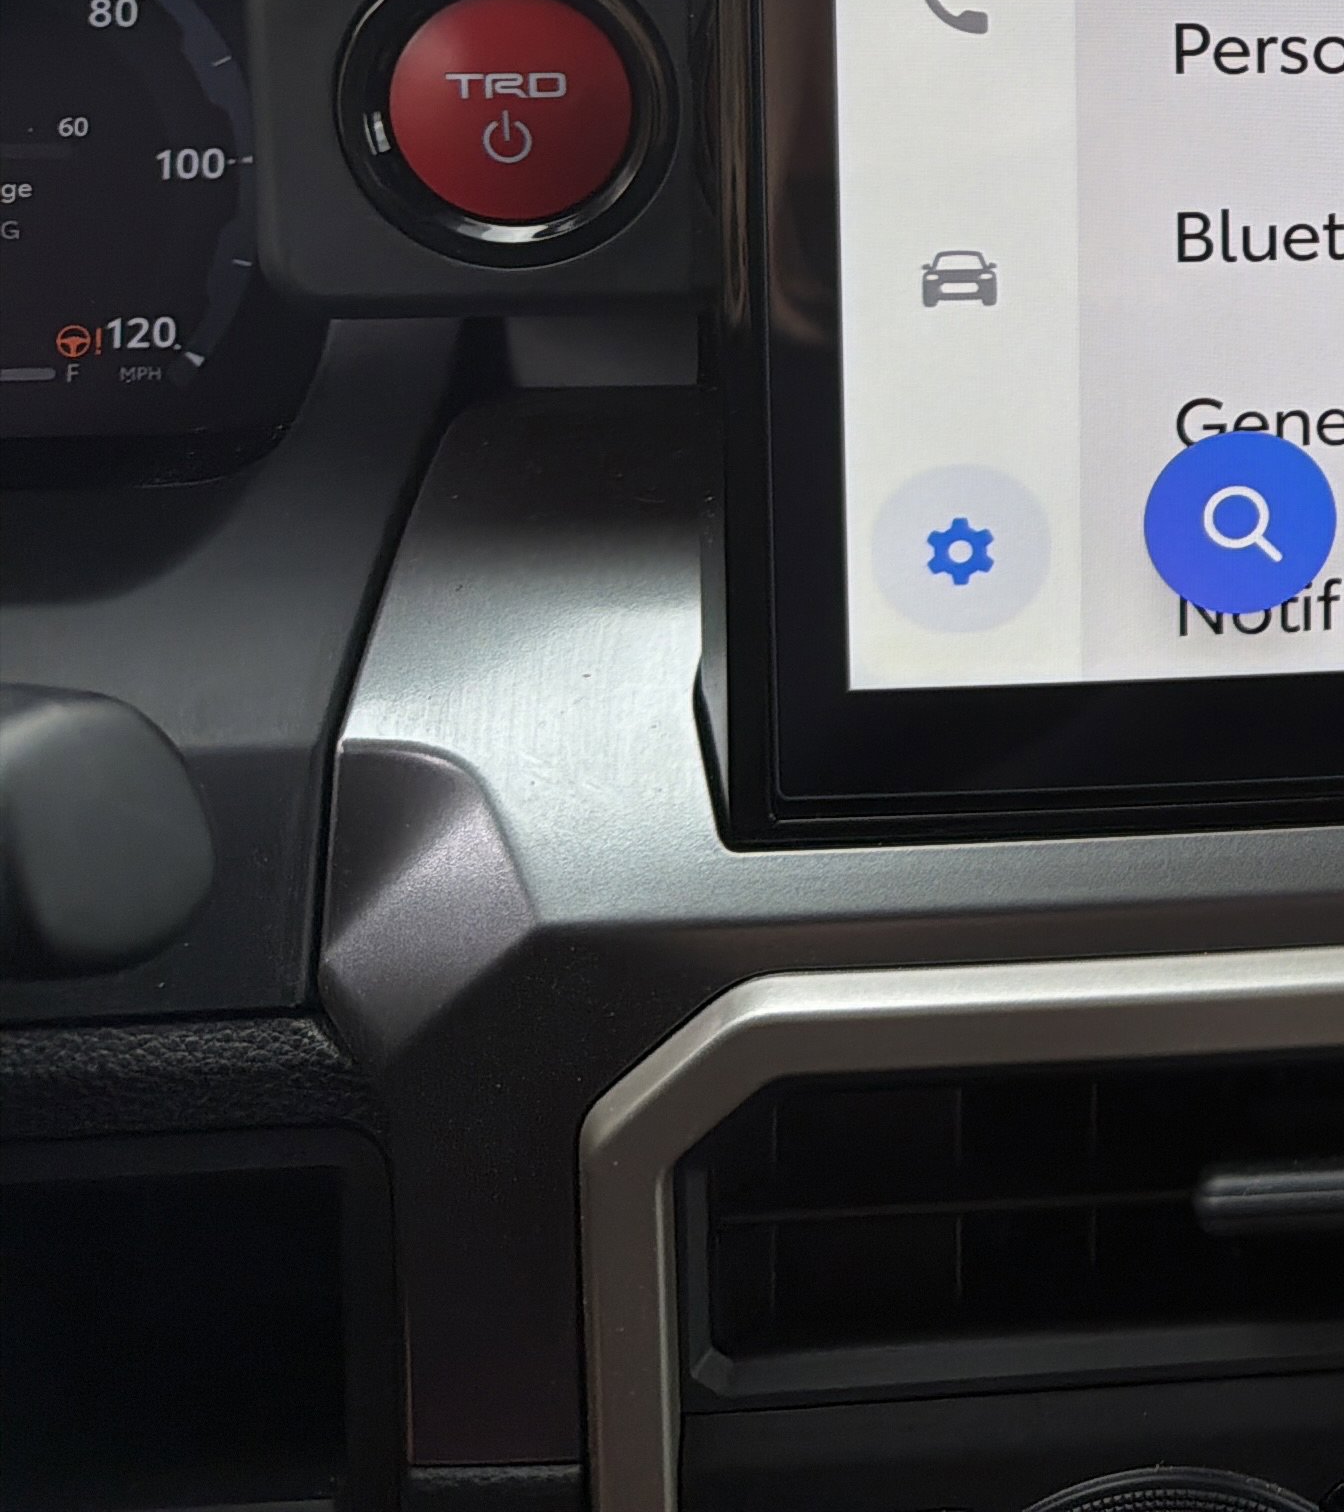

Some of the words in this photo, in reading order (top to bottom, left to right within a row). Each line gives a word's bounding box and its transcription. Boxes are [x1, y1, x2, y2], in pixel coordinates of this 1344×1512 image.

[445, 71, 568, 99] TRD
[58, 116, 89, 137] 60
[155, 147, 226, 180] 100
[106, 316, 177, 349] 120
[66, 363, 80, 383] F
[120, 366, 162, 382] MPH
